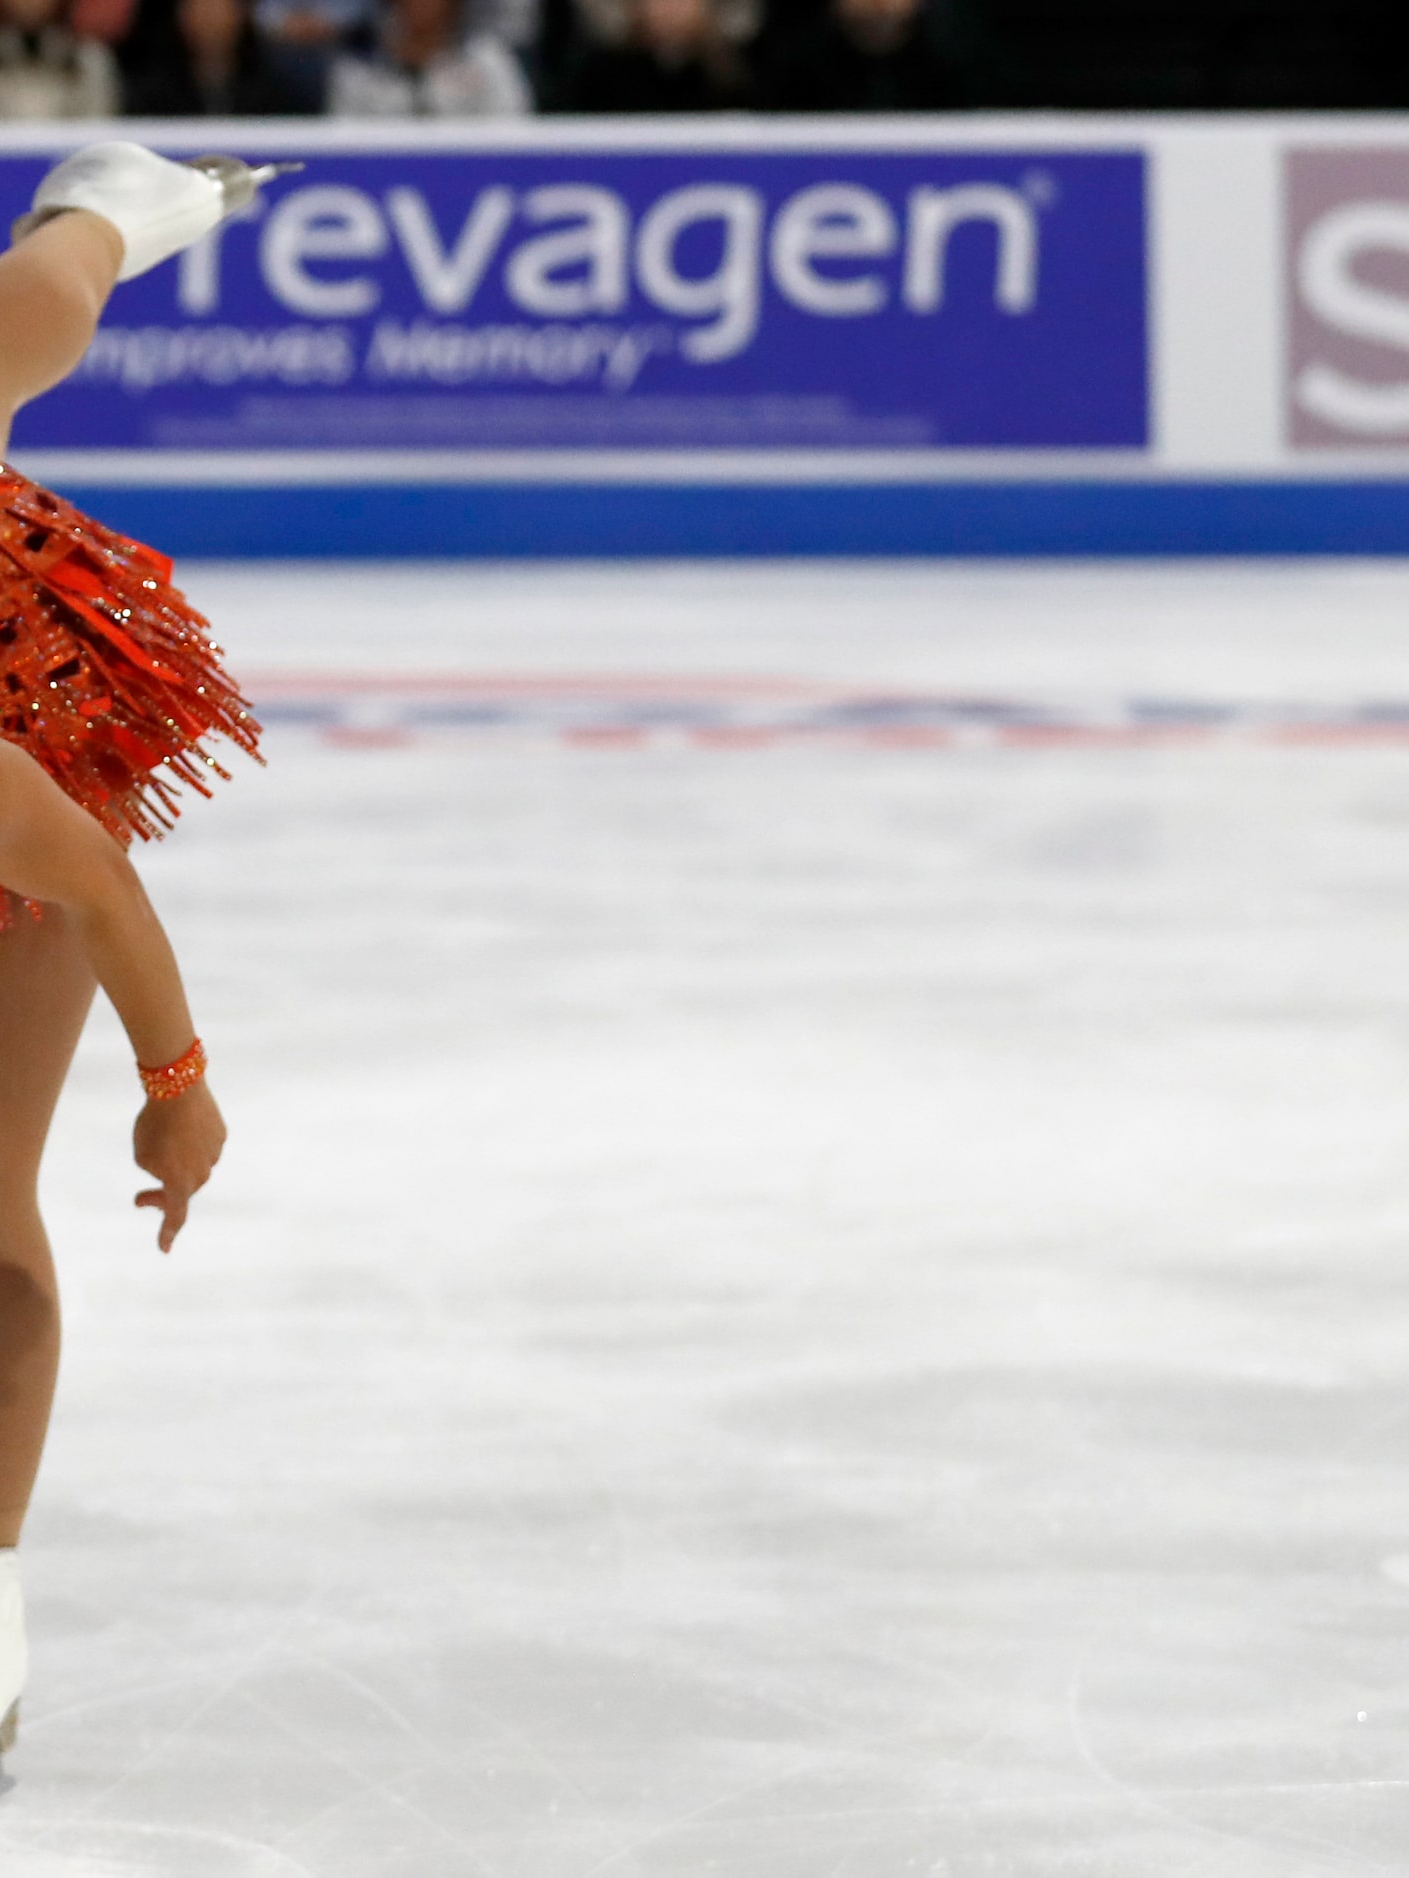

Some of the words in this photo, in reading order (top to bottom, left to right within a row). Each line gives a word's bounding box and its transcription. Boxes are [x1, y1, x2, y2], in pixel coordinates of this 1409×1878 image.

[176, 182, 1039, 363] revagen
[79, 325, 352, 394] mproves
[368, 320, 657, 395] Memory
